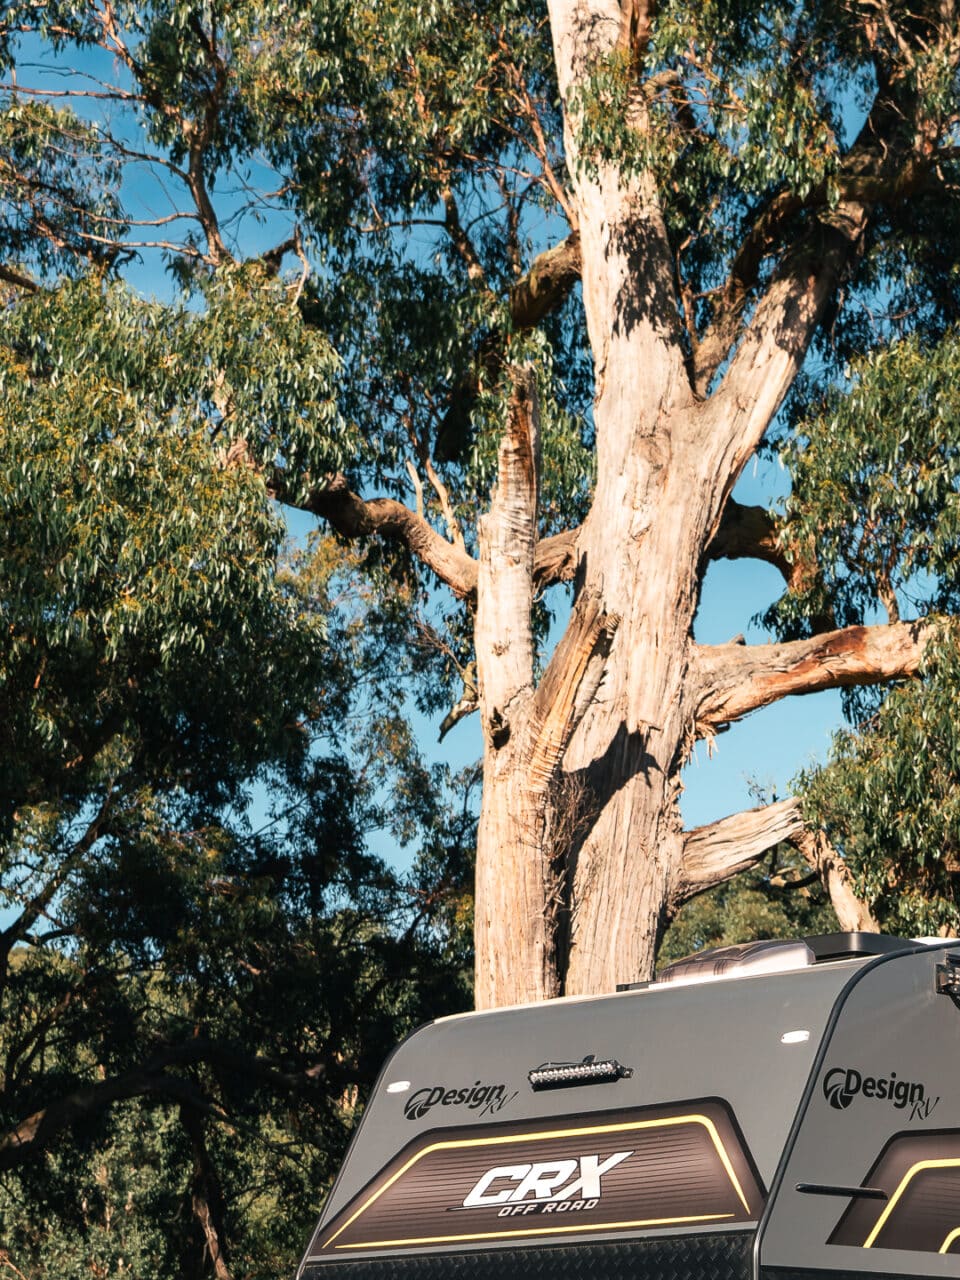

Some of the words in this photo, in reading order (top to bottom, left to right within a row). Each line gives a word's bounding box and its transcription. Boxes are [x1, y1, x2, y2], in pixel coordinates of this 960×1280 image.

[423, 1081, 505, 1109] Design
[844, 1069, 924, 1109] Design
[479, 1091, 519, 1118] RV
[908, 1097, 940, 1121] RV
[462, 1150, 635, 1207] CRX
[497, 1204, 537, 1217] OFF
[541, 1199, 599, 1214] ROAD
